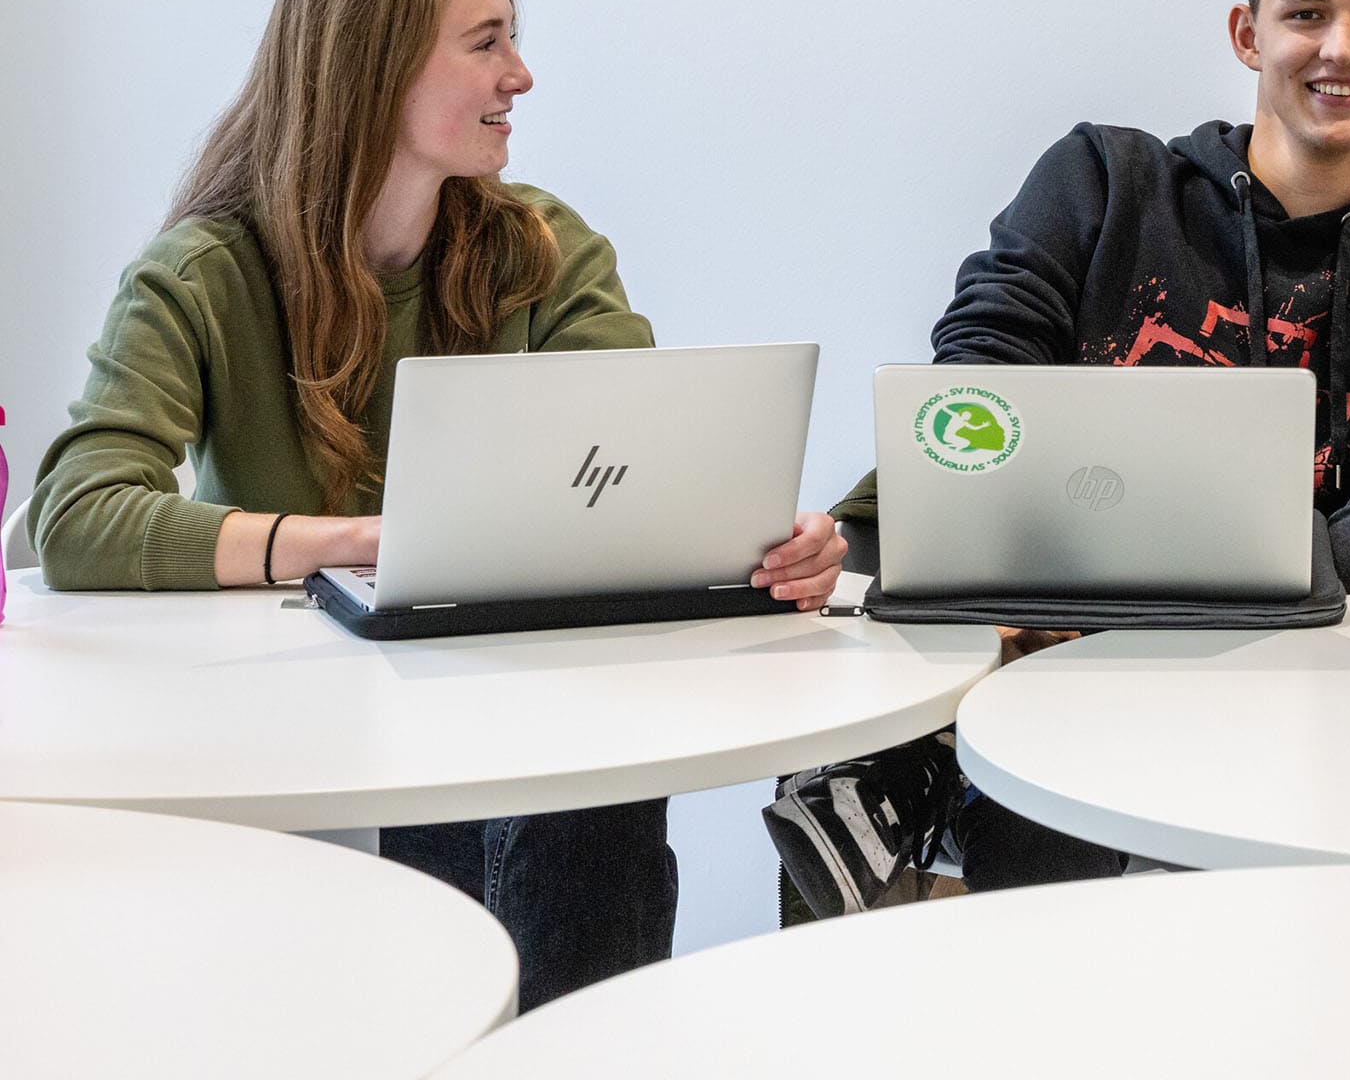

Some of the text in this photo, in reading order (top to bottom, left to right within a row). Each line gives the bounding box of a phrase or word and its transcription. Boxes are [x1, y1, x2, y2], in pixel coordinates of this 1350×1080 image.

[914, 393, 943, 442] sv memos
[949, 387, 1012, 411] sv memos
[923, 447, 986, 472] sv memos
[992, 416, 1021, 465] sv memos
[1071, 466, 1121, 512] hp
